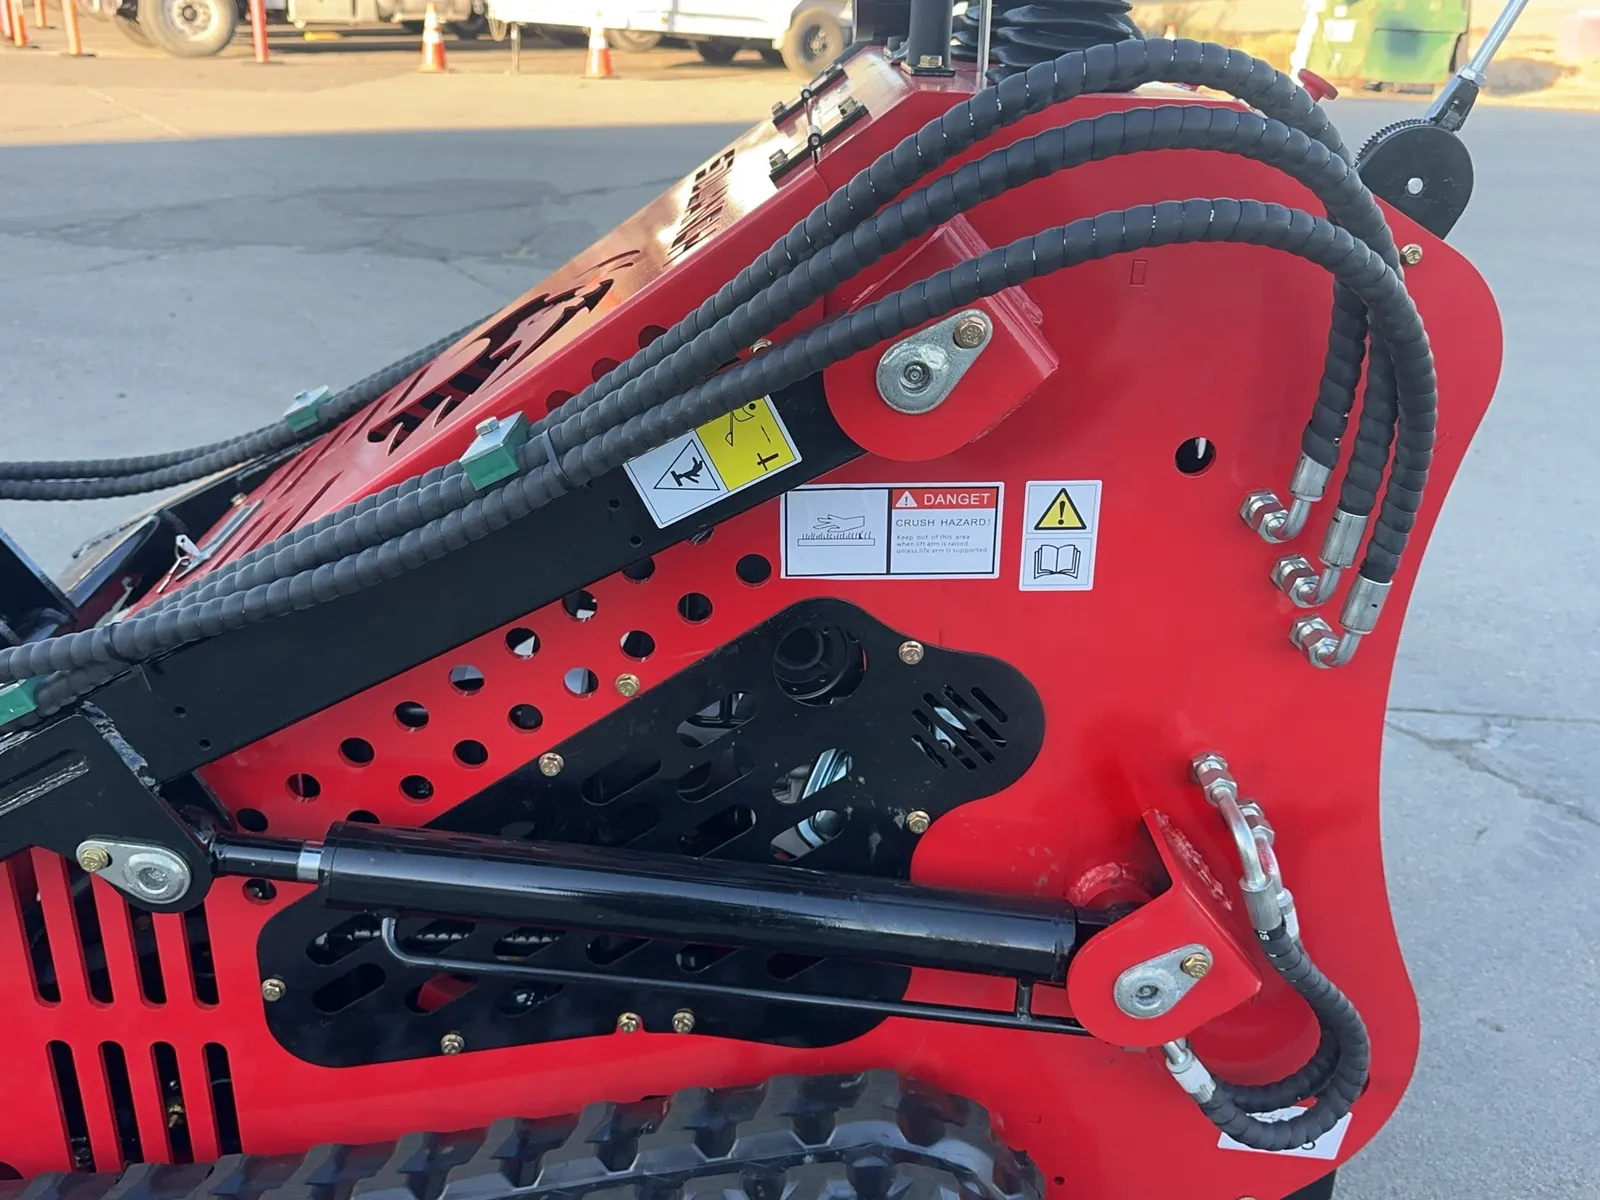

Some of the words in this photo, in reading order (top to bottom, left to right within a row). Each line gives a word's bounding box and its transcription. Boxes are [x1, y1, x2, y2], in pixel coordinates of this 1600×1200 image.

[924, 493, 991, 505] DANGET
[896, 519, 935, 527] CRUSH
[940, 518, 991, 527] HAZARD!
